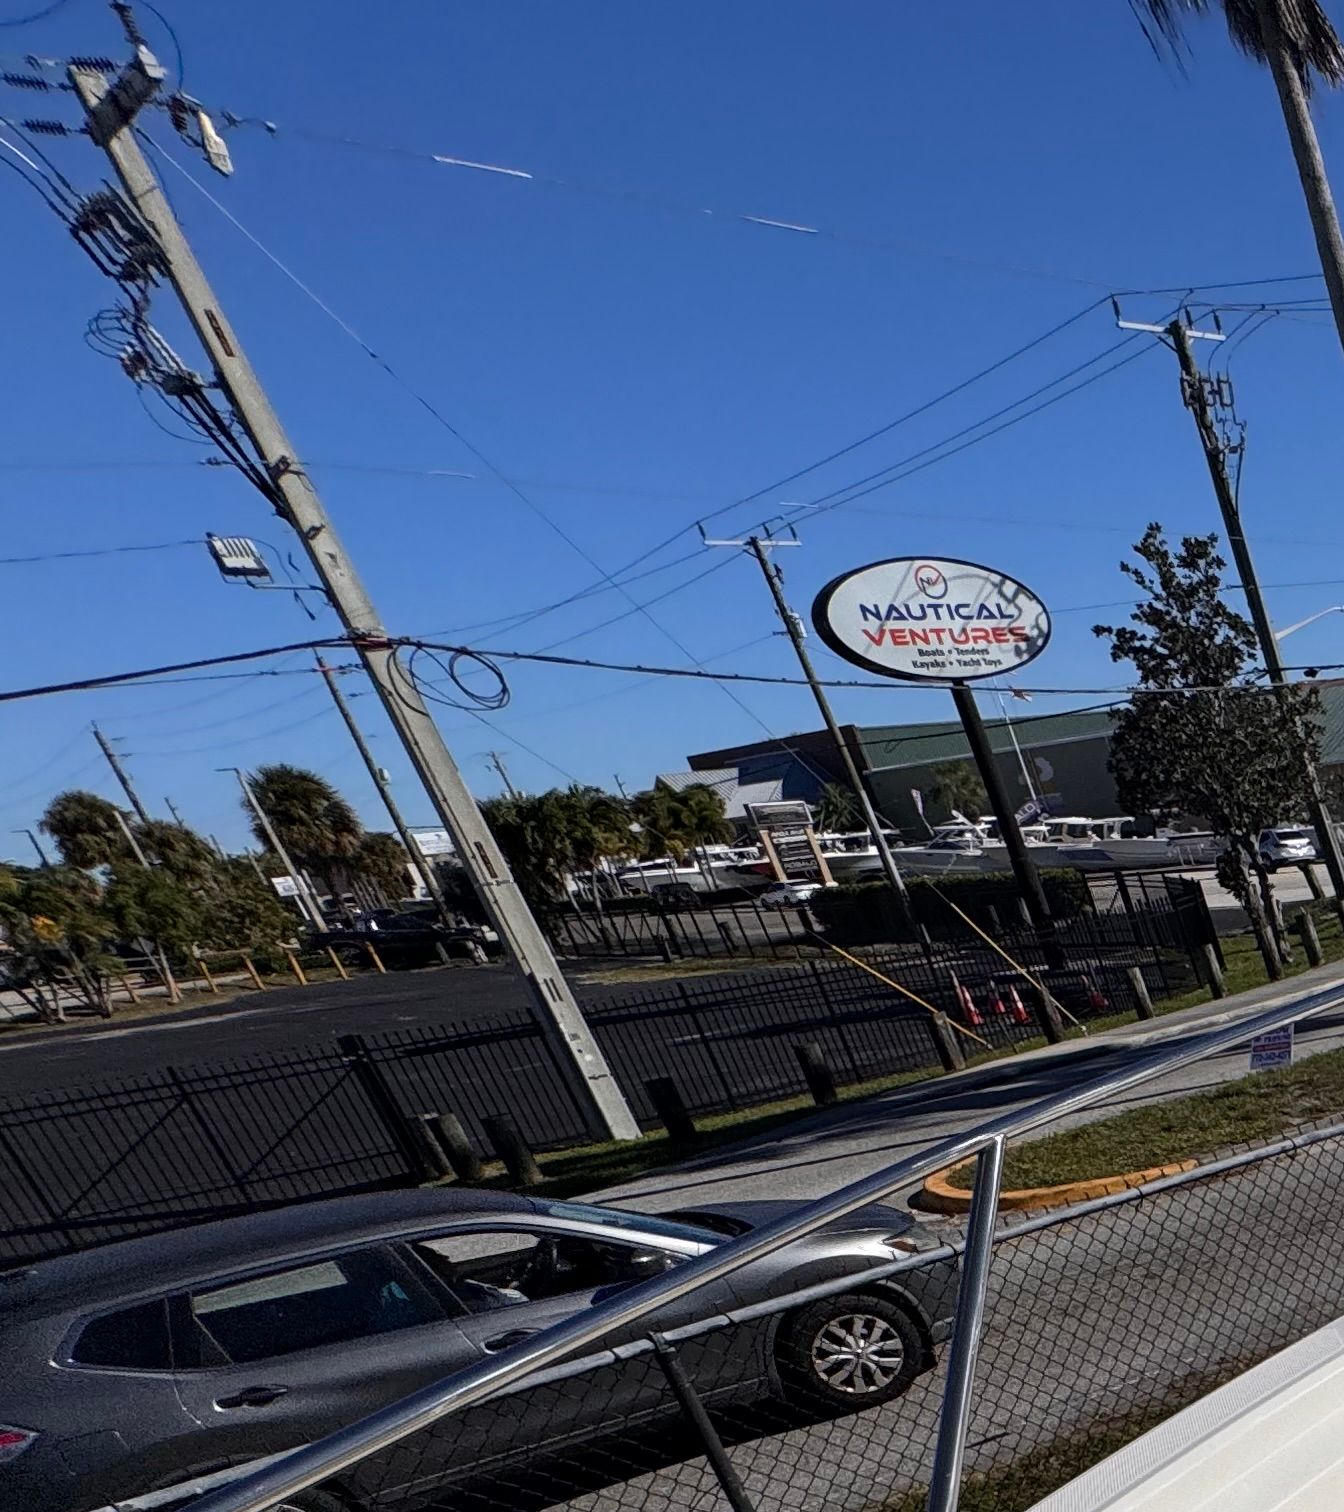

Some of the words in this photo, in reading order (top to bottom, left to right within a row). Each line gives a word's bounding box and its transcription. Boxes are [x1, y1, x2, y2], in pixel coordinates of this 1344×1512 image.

[859, 603, 1014, 621] NAUTICAL
[861, 625, 1030, 647] VENTURES
[917, 648, 945, 657] Boats
[954, 647, 990, 656] Tenders
[912, 660, 947, 671] Kayaks
[957, 659, 982, 668] Yacht
[984, 658, 1003, 668] Toys
